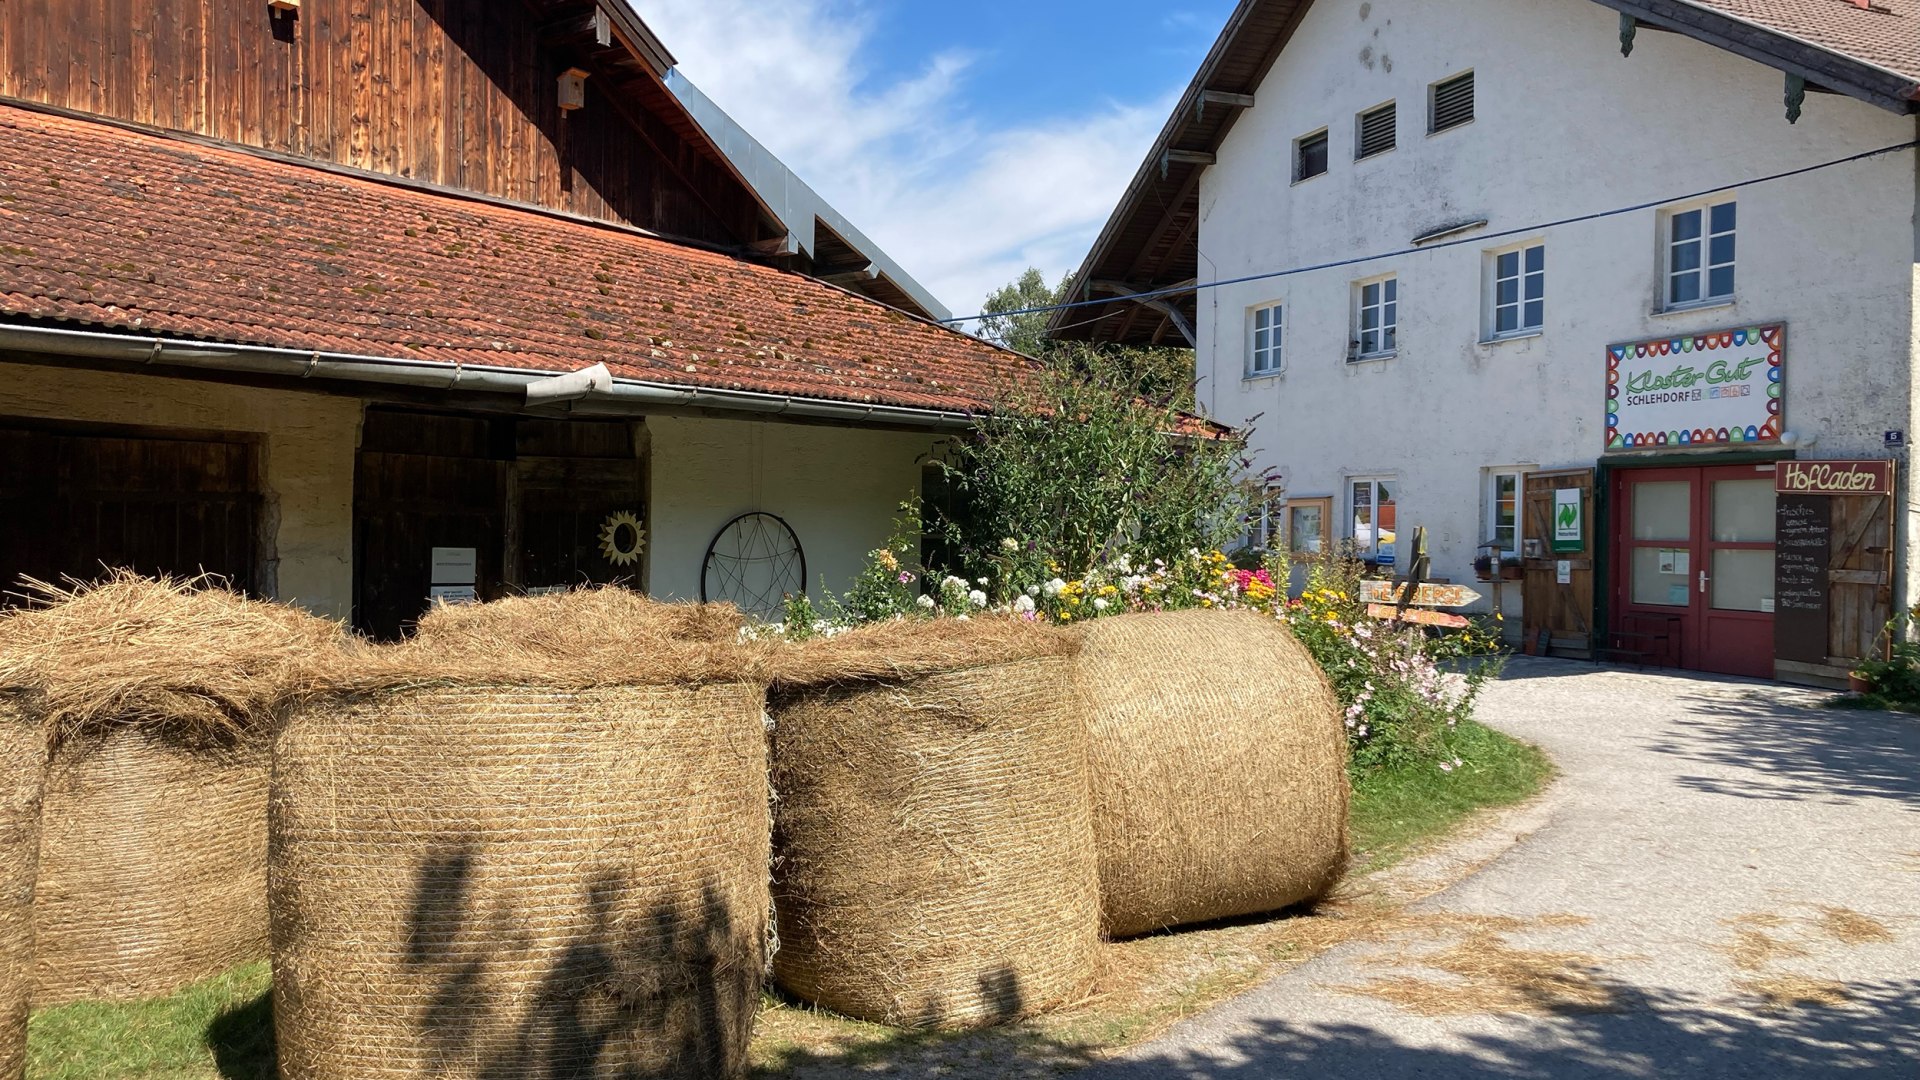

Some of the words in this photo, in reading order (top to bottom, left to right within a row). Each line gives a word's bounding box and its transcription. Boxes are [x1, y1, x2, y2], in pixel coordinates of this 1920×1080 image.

[1626, 365, 1704, 395] Kloster
[1705, 357, 1765, 384] Gut
[1627, 391, 1690, 406] SCHLEHDORF
